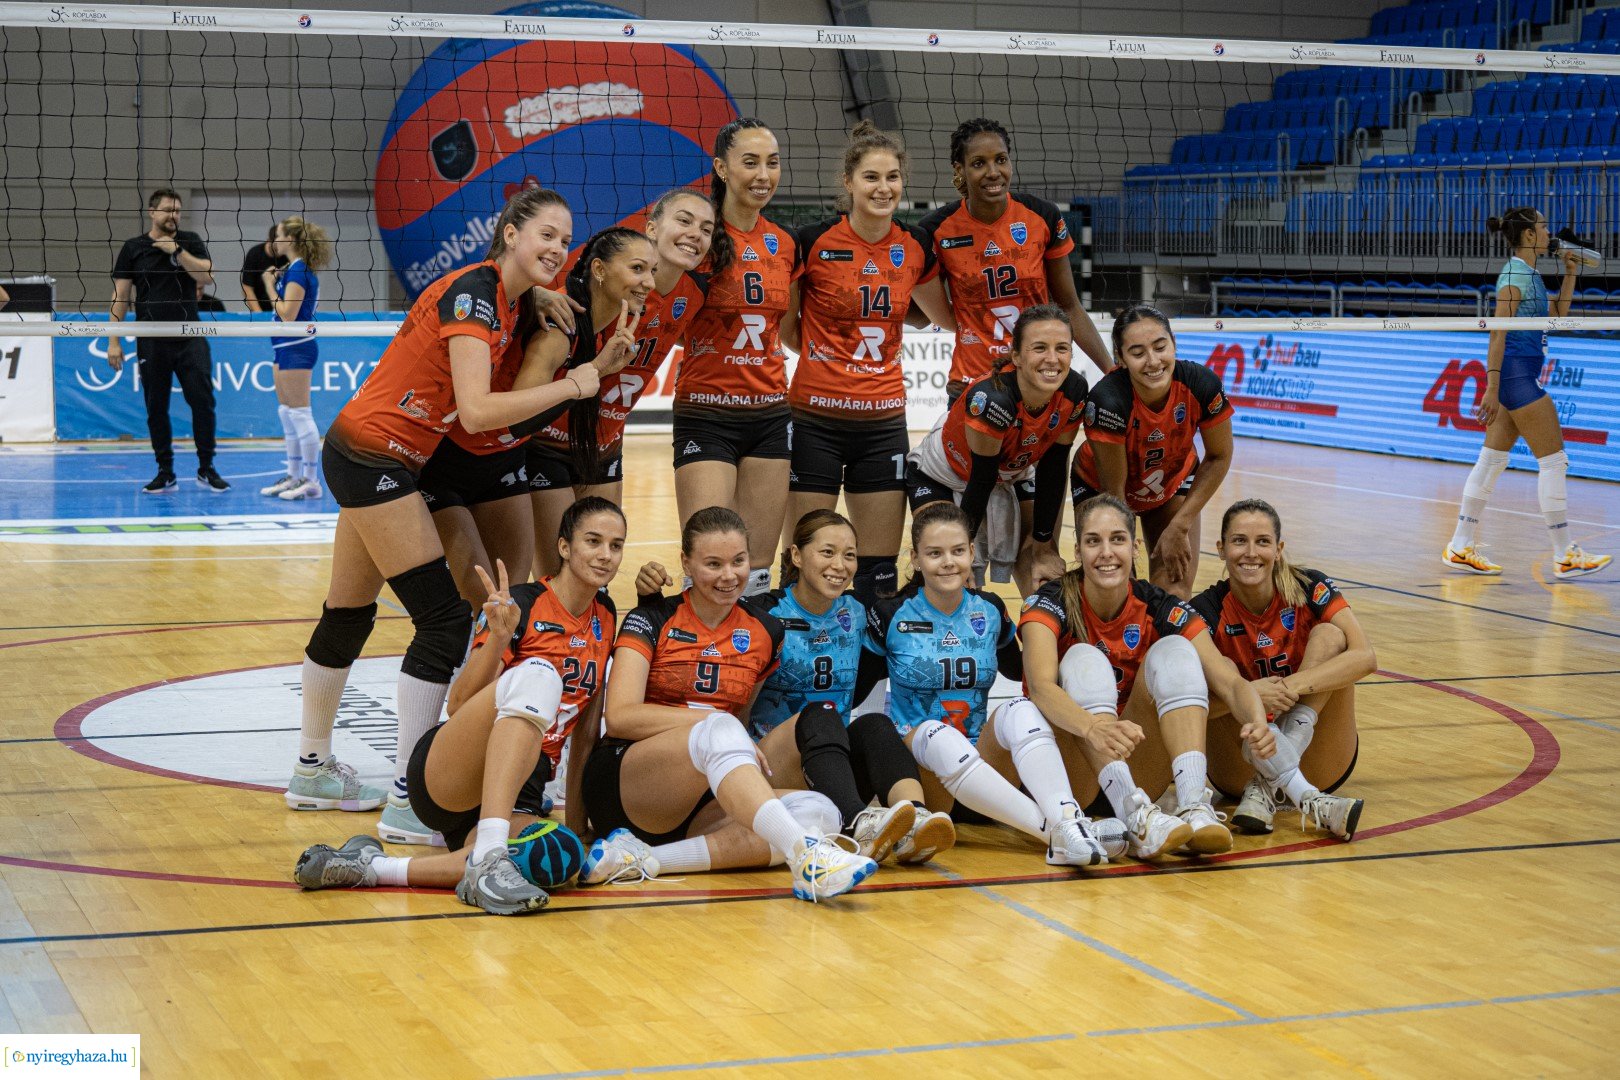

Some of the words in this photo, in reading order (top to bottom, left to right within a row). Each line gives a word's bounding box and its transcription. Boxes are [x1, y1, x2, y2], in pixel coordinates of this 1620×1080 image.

[984, 249, 1001, 257] PEAK
[743, 271, 765, 306] 6
[982, 265, 1019, 300] 12
[858, 285, 892, 319] 14
[724, 353, 767, 366] rieker
[689, 392, 751, 405] PRIMĂRIA
[809, 396, 872, 411] PRIMĂRIA
[875, 396, 904, 410] LUGOJ
[683, 446, 702, 455] PEAK
[1144, 447, 1165, 472] 2
[376, 481, 400, 492] PEAK
[942, 639, 960, 647] PEAK
[561, 656, 598, 698] 24
[694, 662, 721, 695] 9
[813, 655, 833, 691] 8
[938, 656, 977, 691] 19
[1254, 653, 1293, 679] 15
